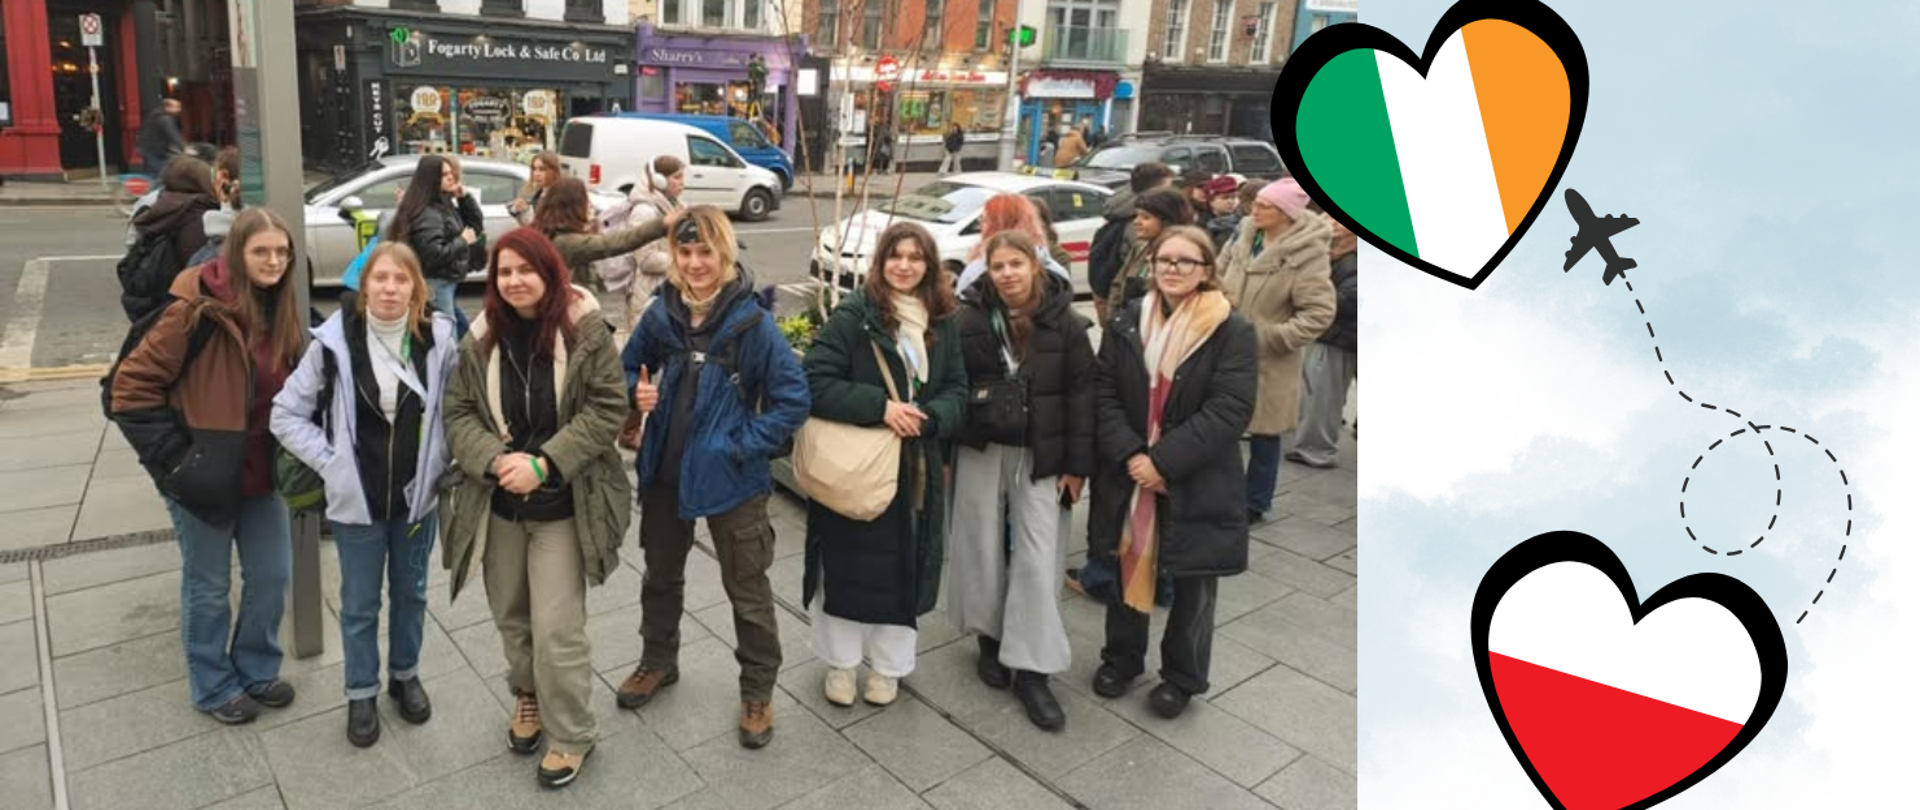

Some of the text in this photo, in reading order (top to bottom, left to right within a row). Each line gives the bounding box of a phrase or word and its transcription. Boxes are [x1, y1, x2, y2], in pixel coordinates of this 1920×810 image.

[428, 39, 606, 63] Fogarty Lock & Safe Co Ltd
